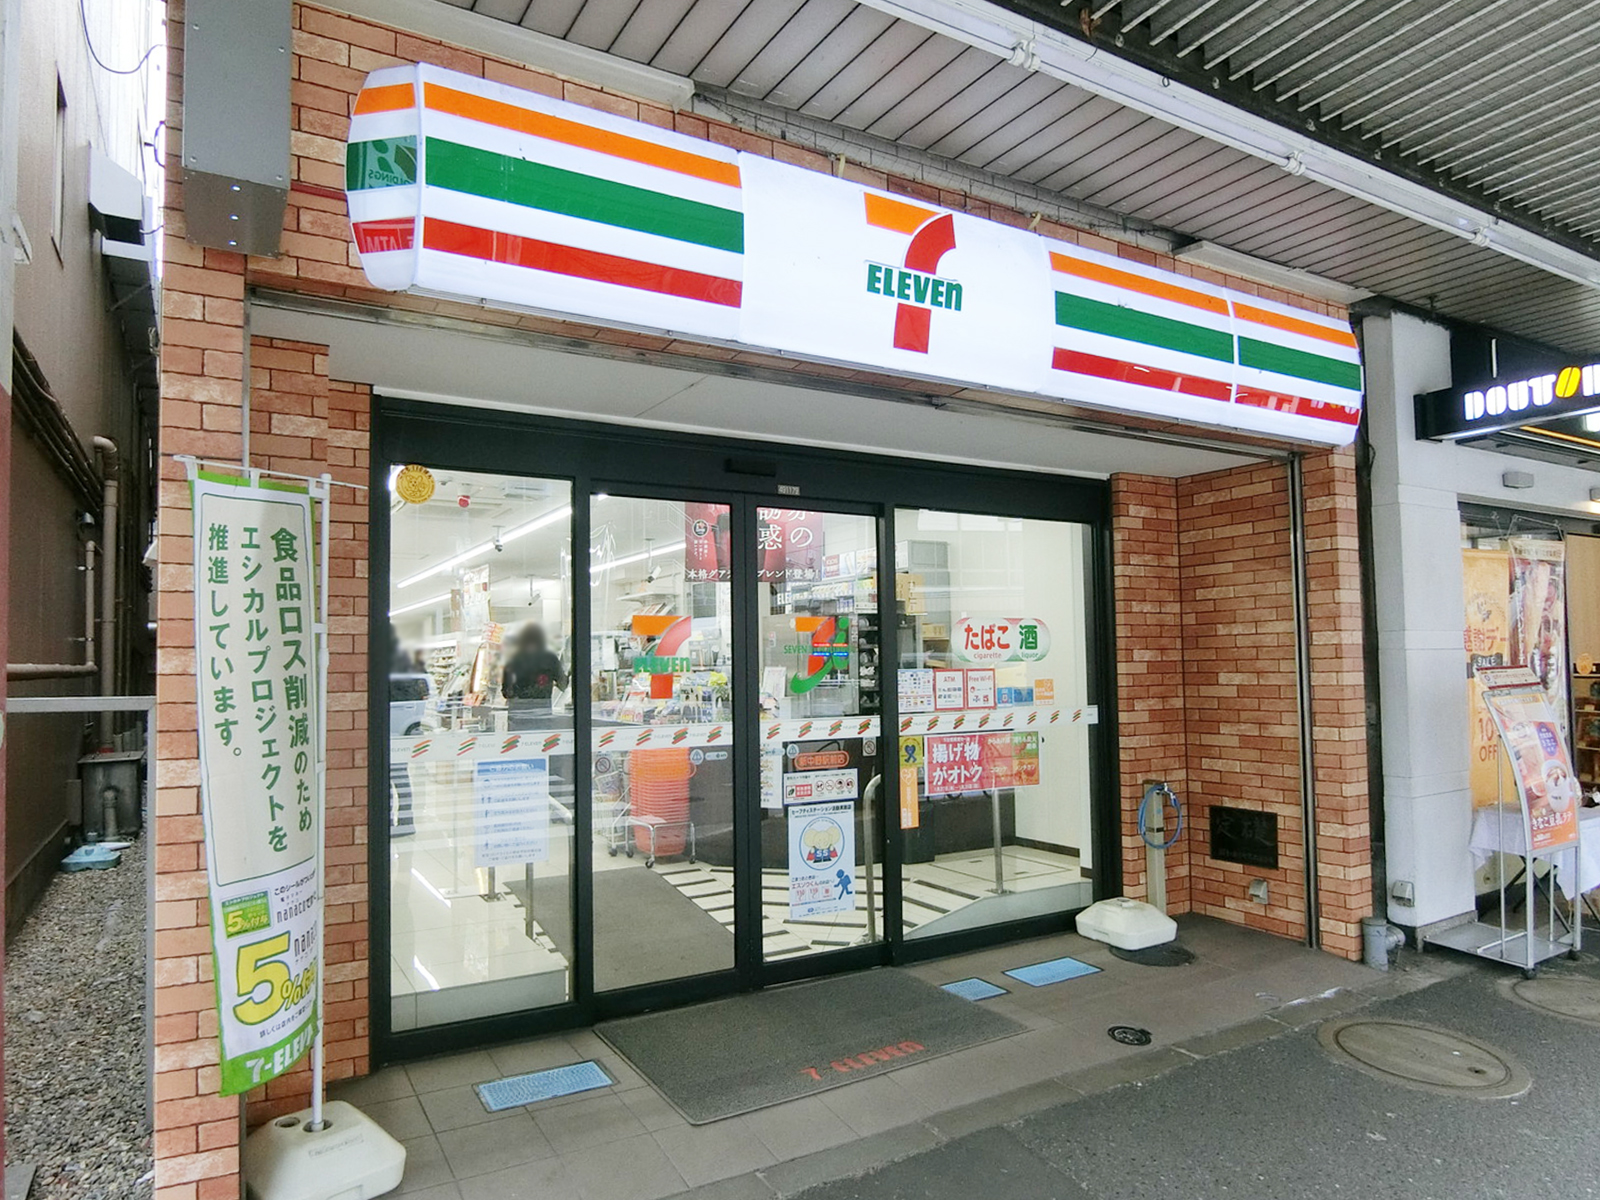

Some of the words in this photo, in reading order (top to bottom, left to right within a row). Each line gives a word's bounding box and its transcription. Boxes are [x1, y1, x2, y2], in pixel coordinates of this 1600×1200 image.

[207, 522, 242, 757] 推進しています。
[964, 624, 1010, 650] たばこ
[1018, 624, 1038, 651] 酒
[973, 652, 1002, 661] cigarette
[241, 526, 288, 853] エシカルプロジェクトを
[270, 527, 313, 833] 食品ロス削減のため
[932, 743, 981, 764] 揚げ物
[932, 764, 983, 786] がオトク
